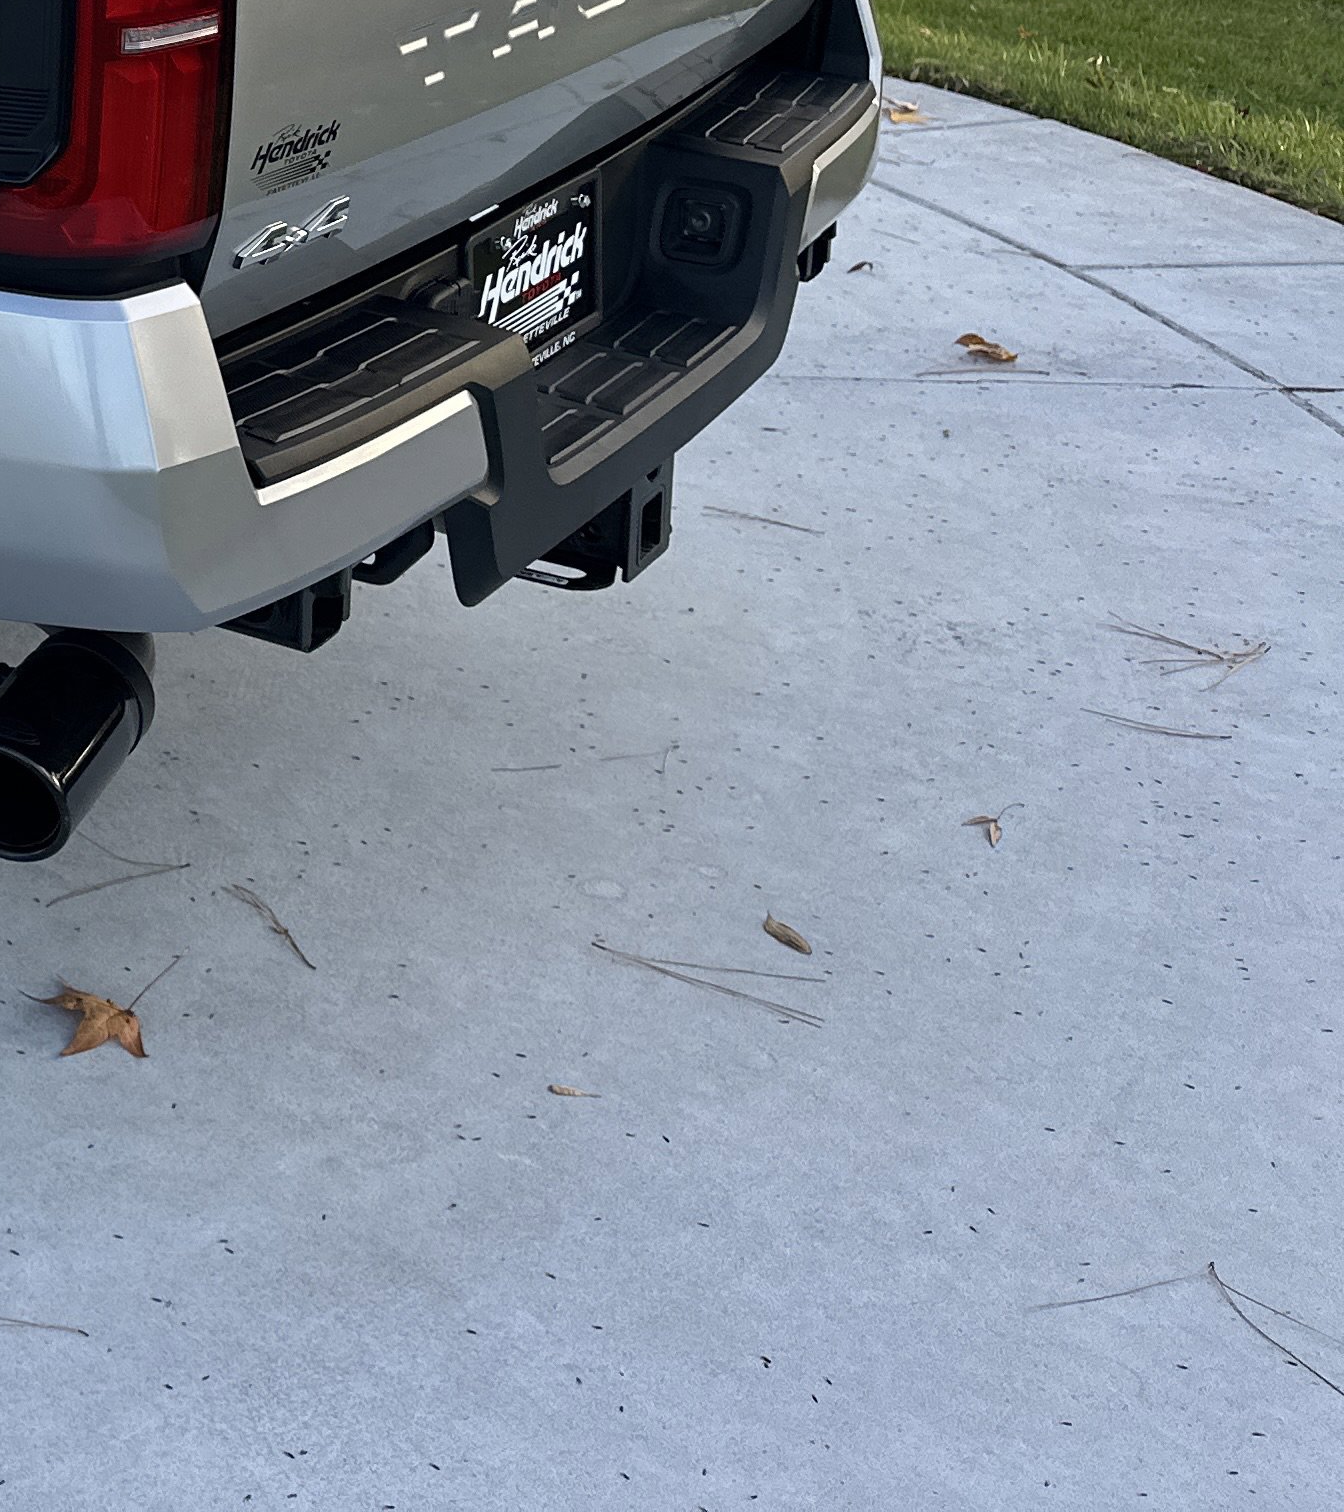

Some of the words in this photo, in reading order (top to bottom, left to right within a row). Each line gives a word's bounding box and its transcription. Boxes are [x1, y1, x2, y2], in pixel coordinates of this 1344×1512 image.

[250, 119, 342, 175] Hendrick
[283, 149, 318, 166] TOYOTA
[513, 198, 559, 239] Hendrick
[477, 221, 587, 325] Hendrick
[521, 271, 562, 304] TOYOTA
[523, 306, 570, 344] ETTEVILLE
